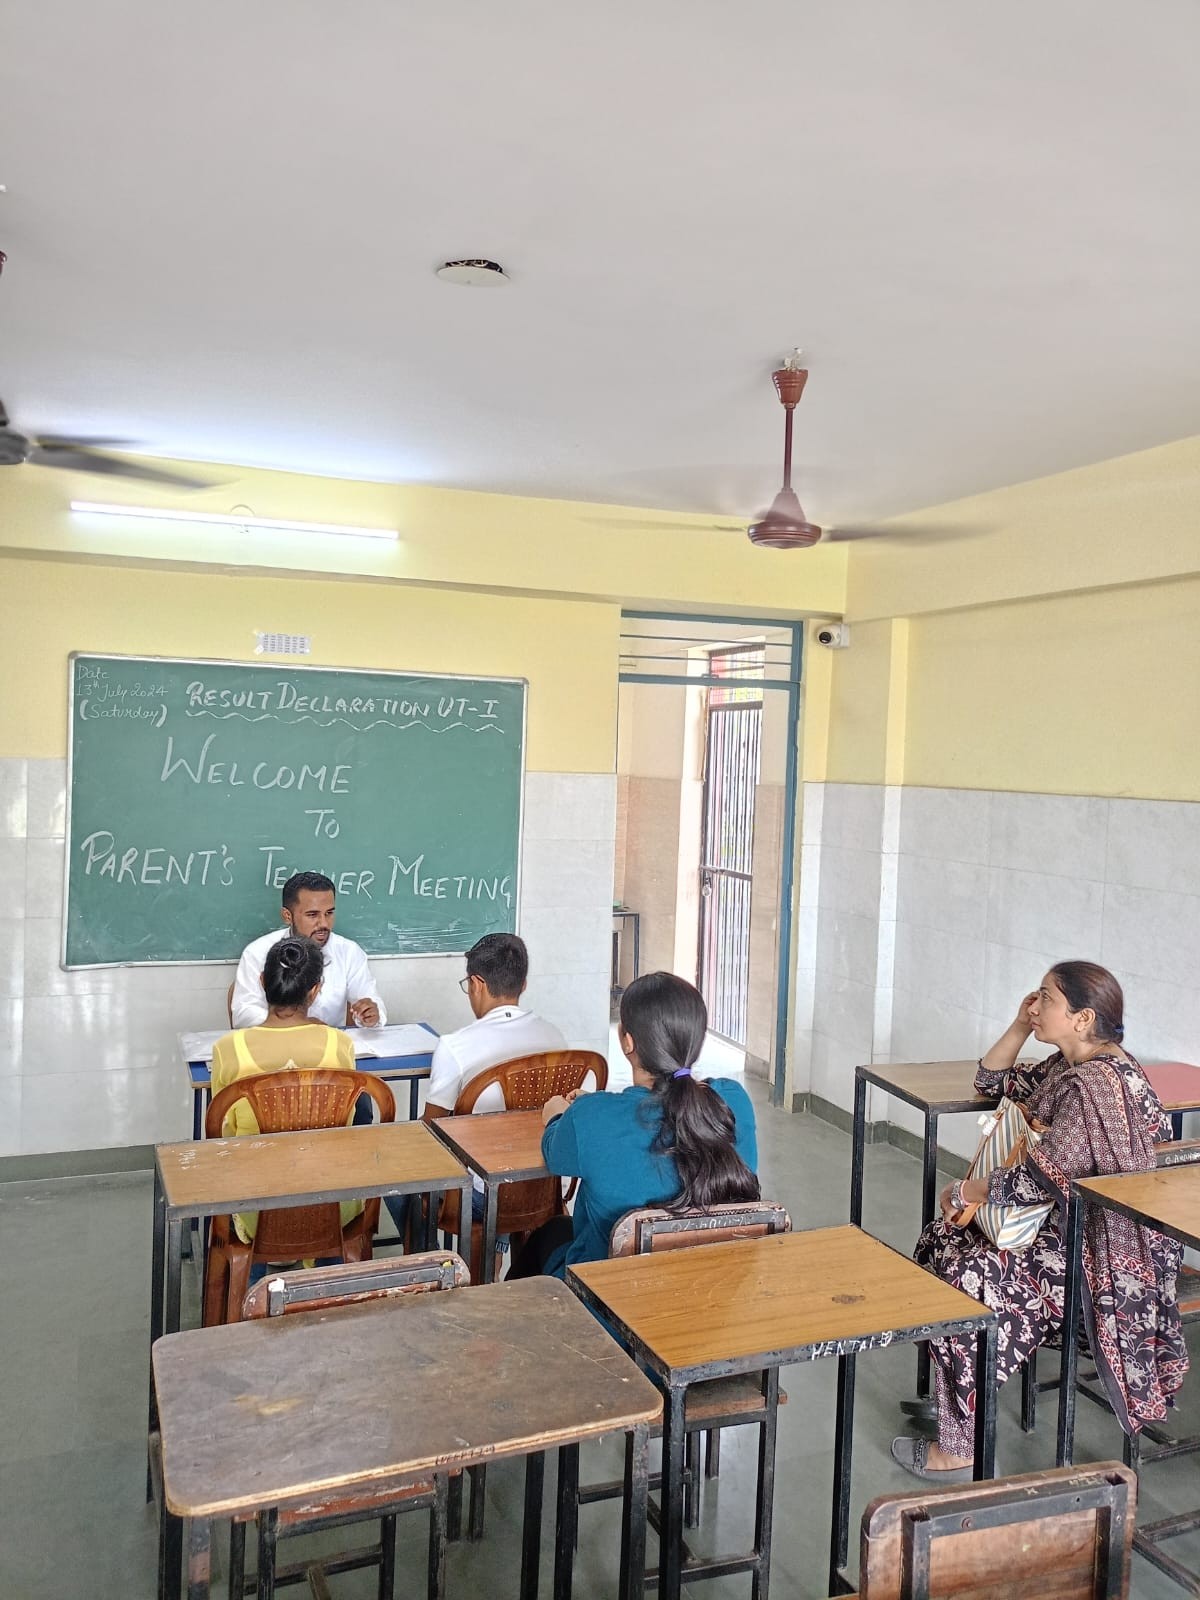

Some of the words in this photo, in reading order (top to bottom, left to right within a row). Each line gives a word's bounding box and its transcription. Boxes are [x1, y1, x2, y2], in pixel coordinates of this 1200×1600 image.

[97, 684, 128, 703] July
[130, 682, 169, 697] 2024
[186, 681, 273, 710] RESULT
[276, 682, 430, 718] DECLARATION
[437, 697, 499, 718] UT-I
[160, 733, 352, 793] WELCOME
[80, 830, 236, 886] PARENT'S
[258, 846, 375, 900] TEER
[388, 854, 512, 909] MEETING
[811, 1336, 877, 1360] HENTAI
